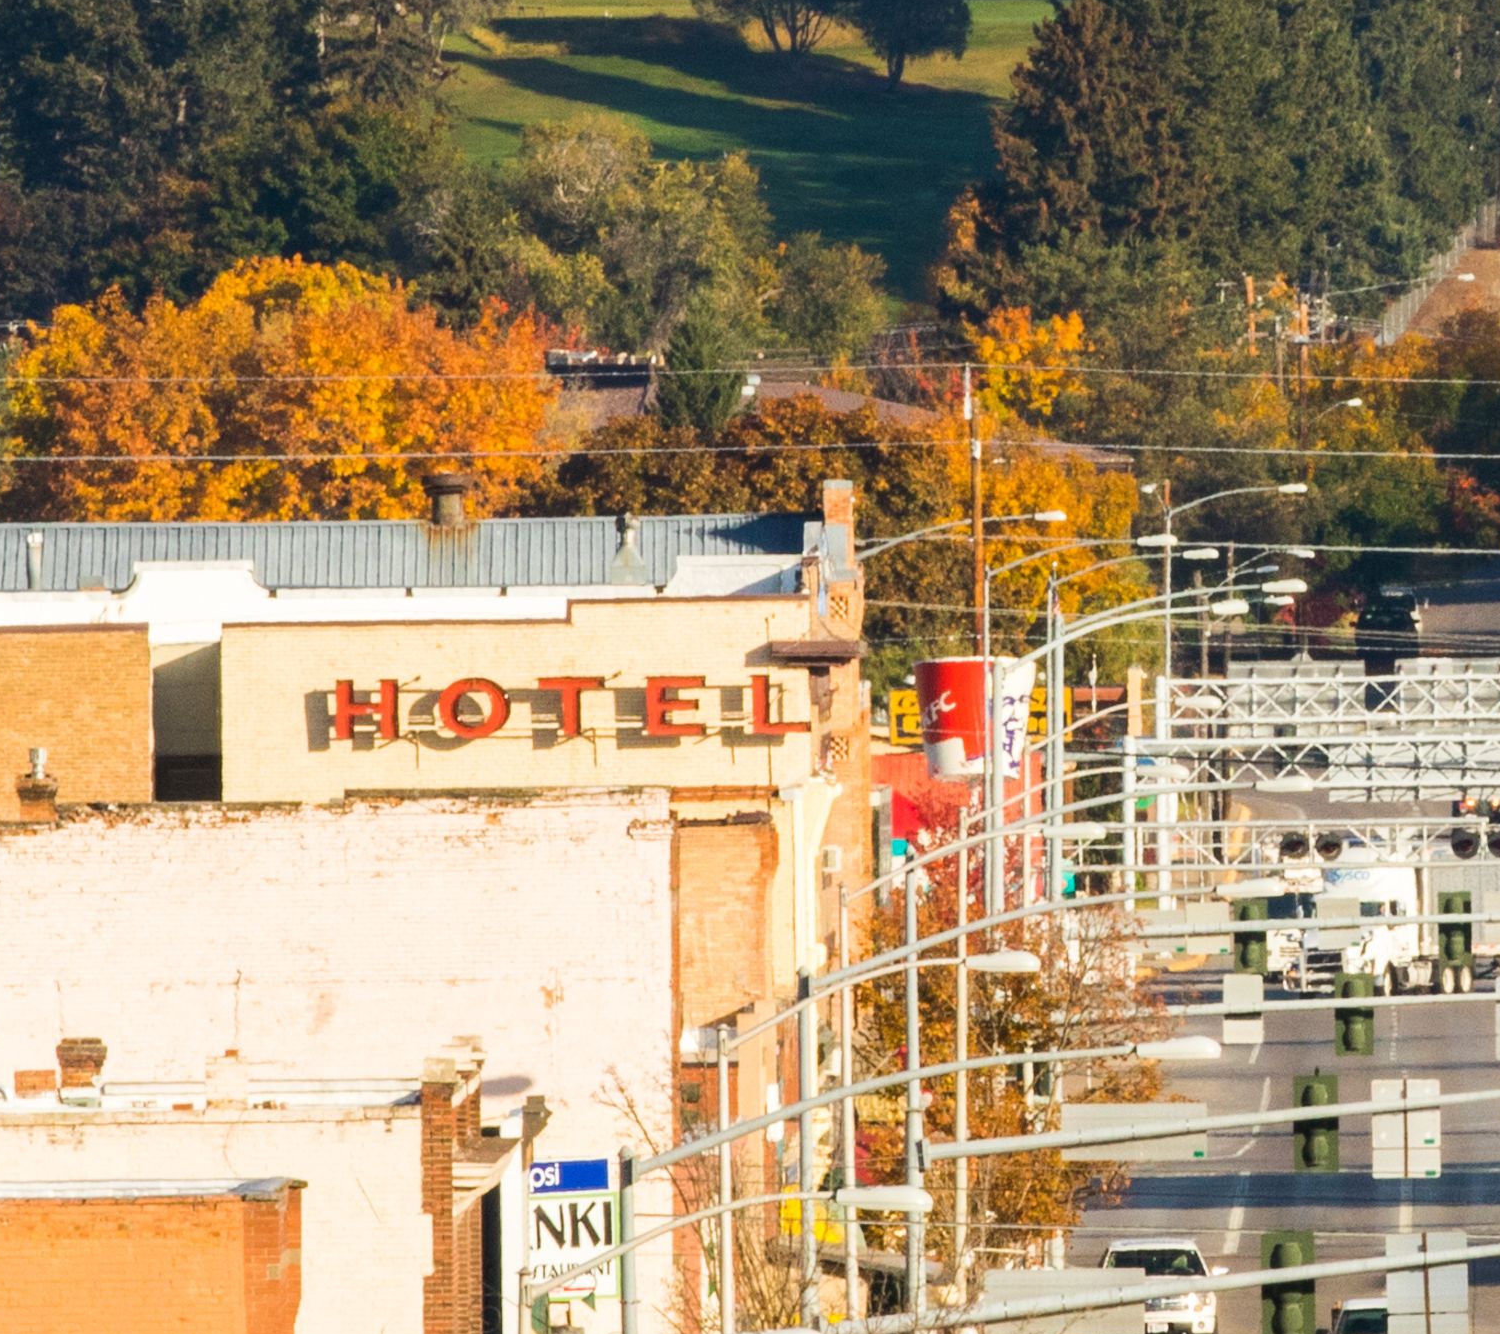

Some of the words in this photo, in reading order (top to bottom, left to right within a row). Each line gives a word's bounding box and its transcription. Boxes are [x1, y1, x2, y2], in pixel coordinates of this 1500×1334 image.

[334, 674, 812, 739] HOTEL
[528, 1162, 560, 1193] psi
[531, 1200, 613, 1250] NKI
